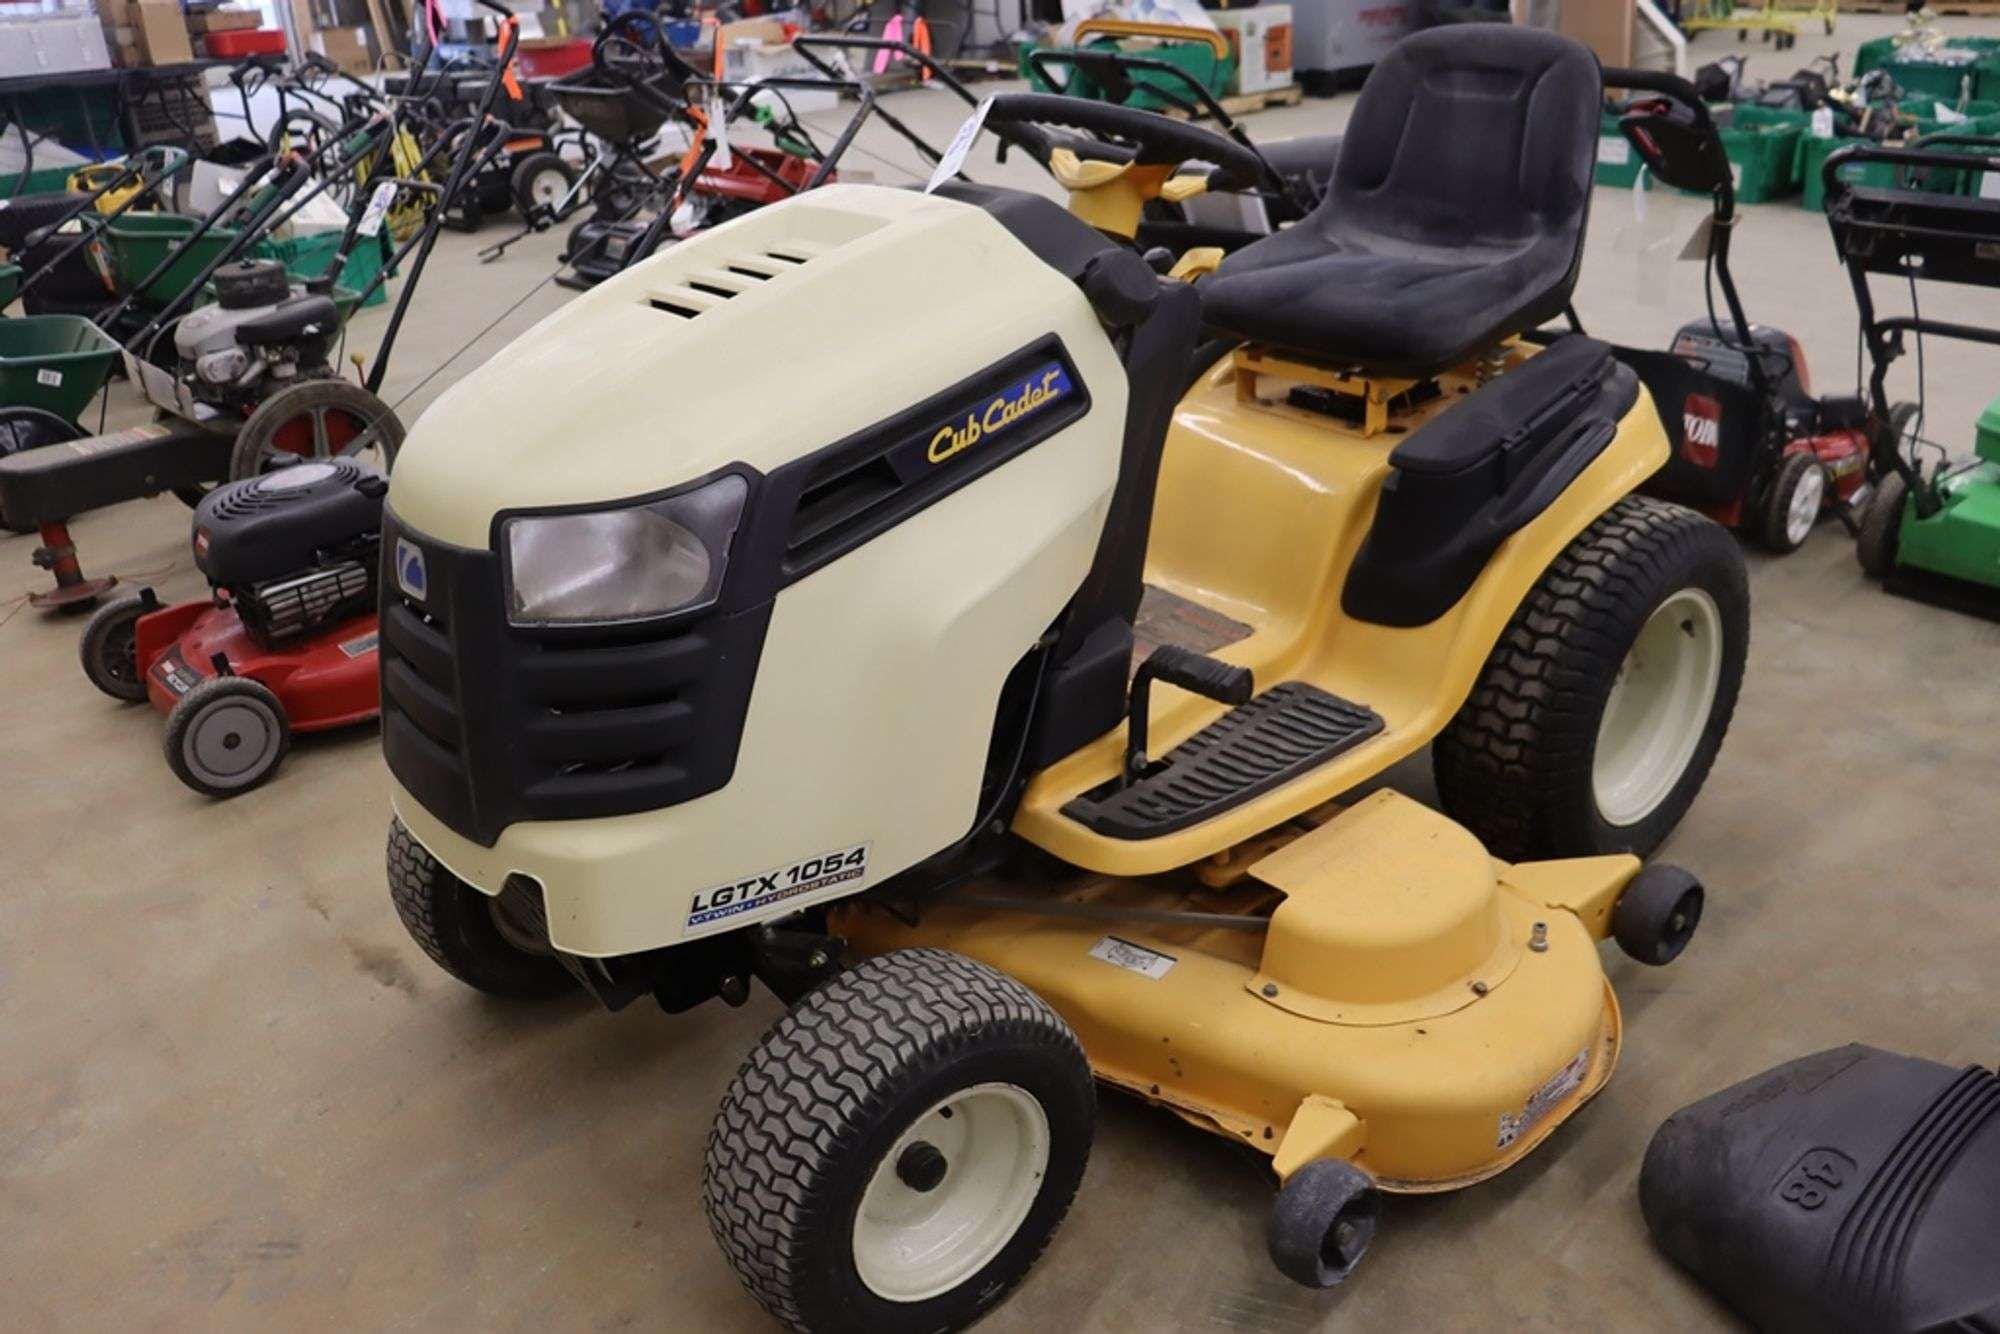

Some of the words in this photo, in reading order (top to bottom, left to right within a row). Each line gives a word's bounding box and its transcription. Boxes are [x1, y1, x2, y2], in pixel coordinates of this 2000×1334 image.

[928, 413, 981, 464] Cub
[982, 370, 1061, 434] Cadet
[691, 871, 780, 914] LGTX
[787, 847, 866, 884] 1054
[1780, 1160, 1842, 1211] 48
